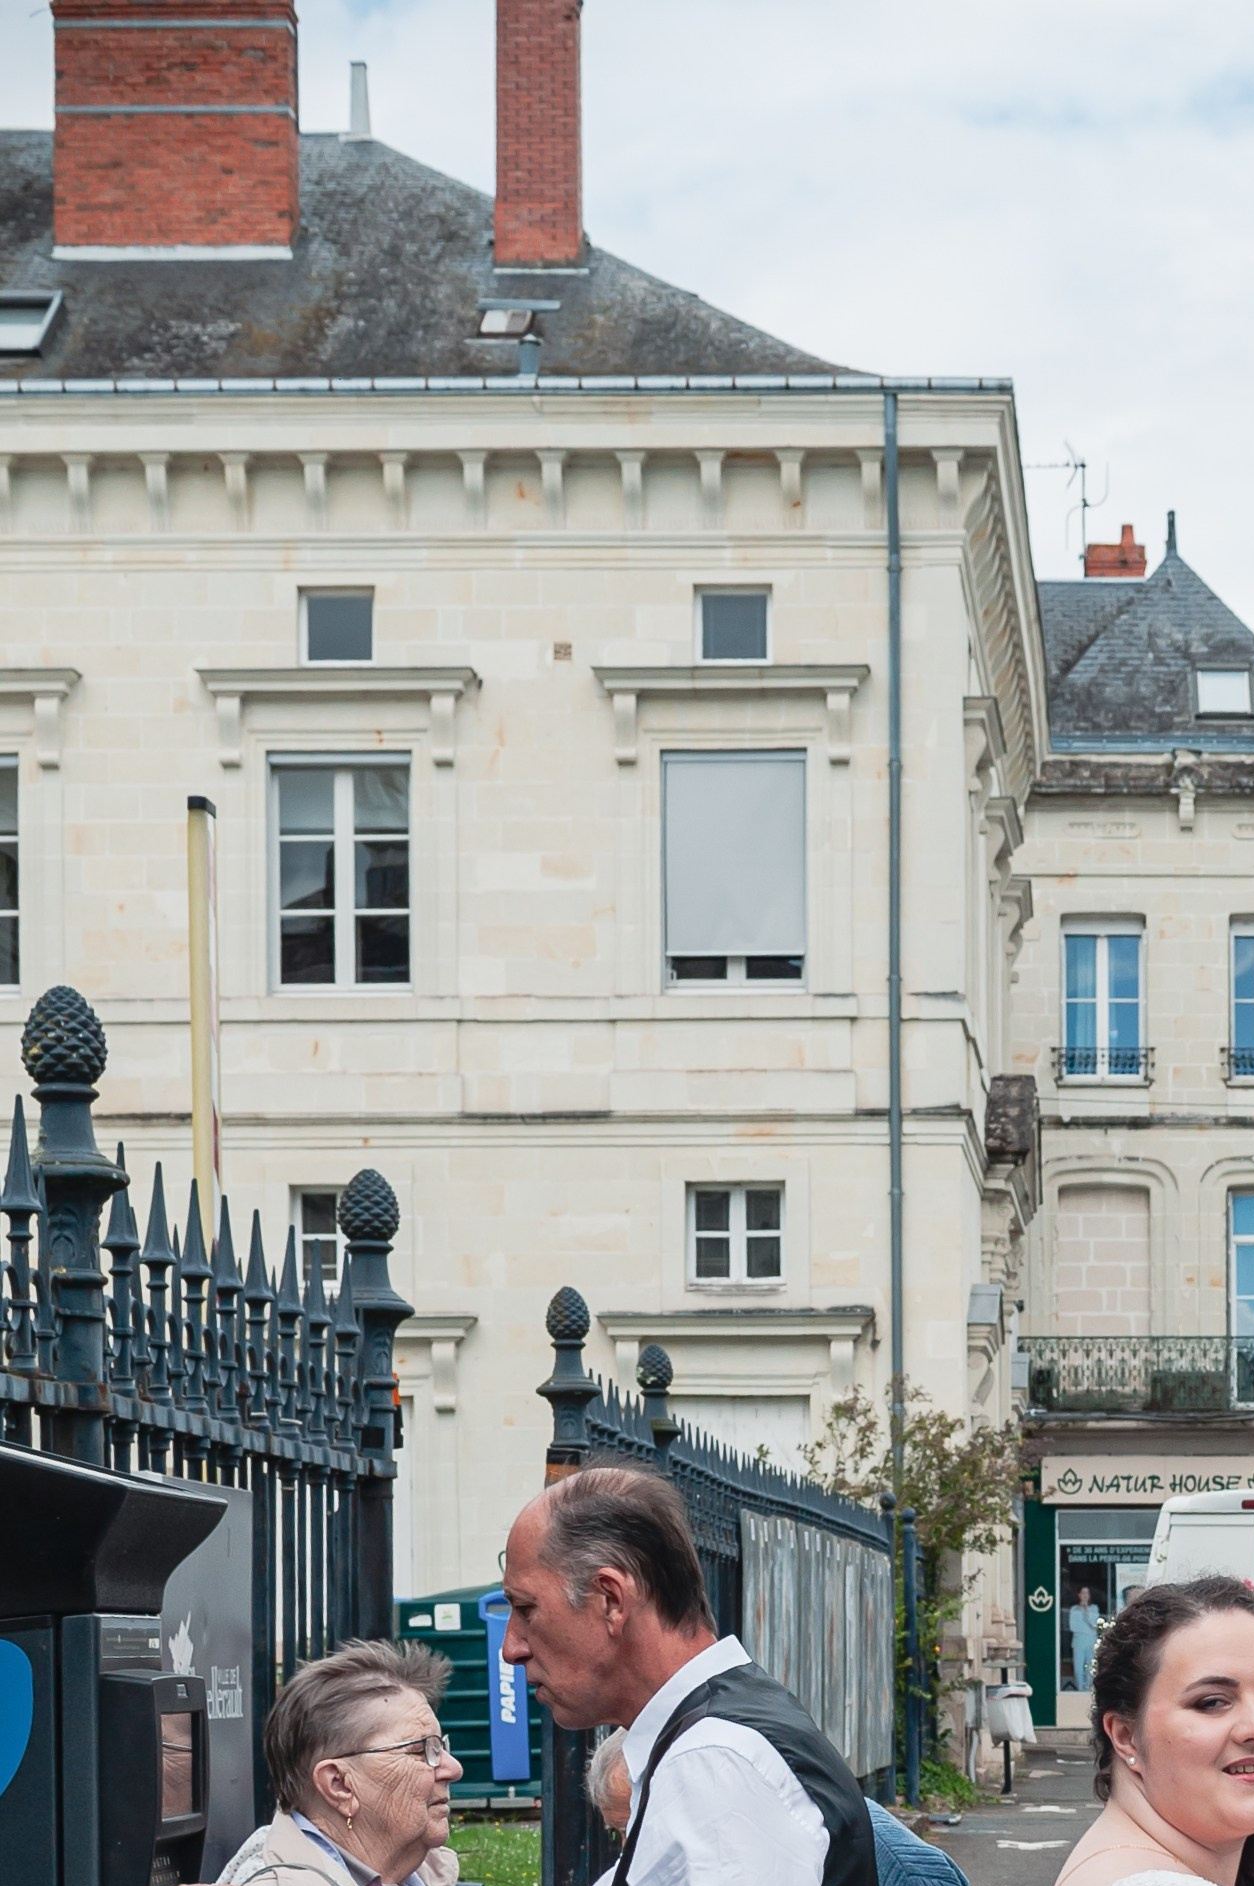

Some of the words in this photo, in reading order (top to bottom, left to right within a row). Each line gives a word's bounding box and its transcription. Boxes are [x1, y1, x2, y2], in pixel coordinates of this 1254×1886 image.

[1088, 1474, 1165, 1494] NATUR
[1169, 1474, 1242, 1494] HOUSE
[498, 1647, 517, 1724] PAPIE
